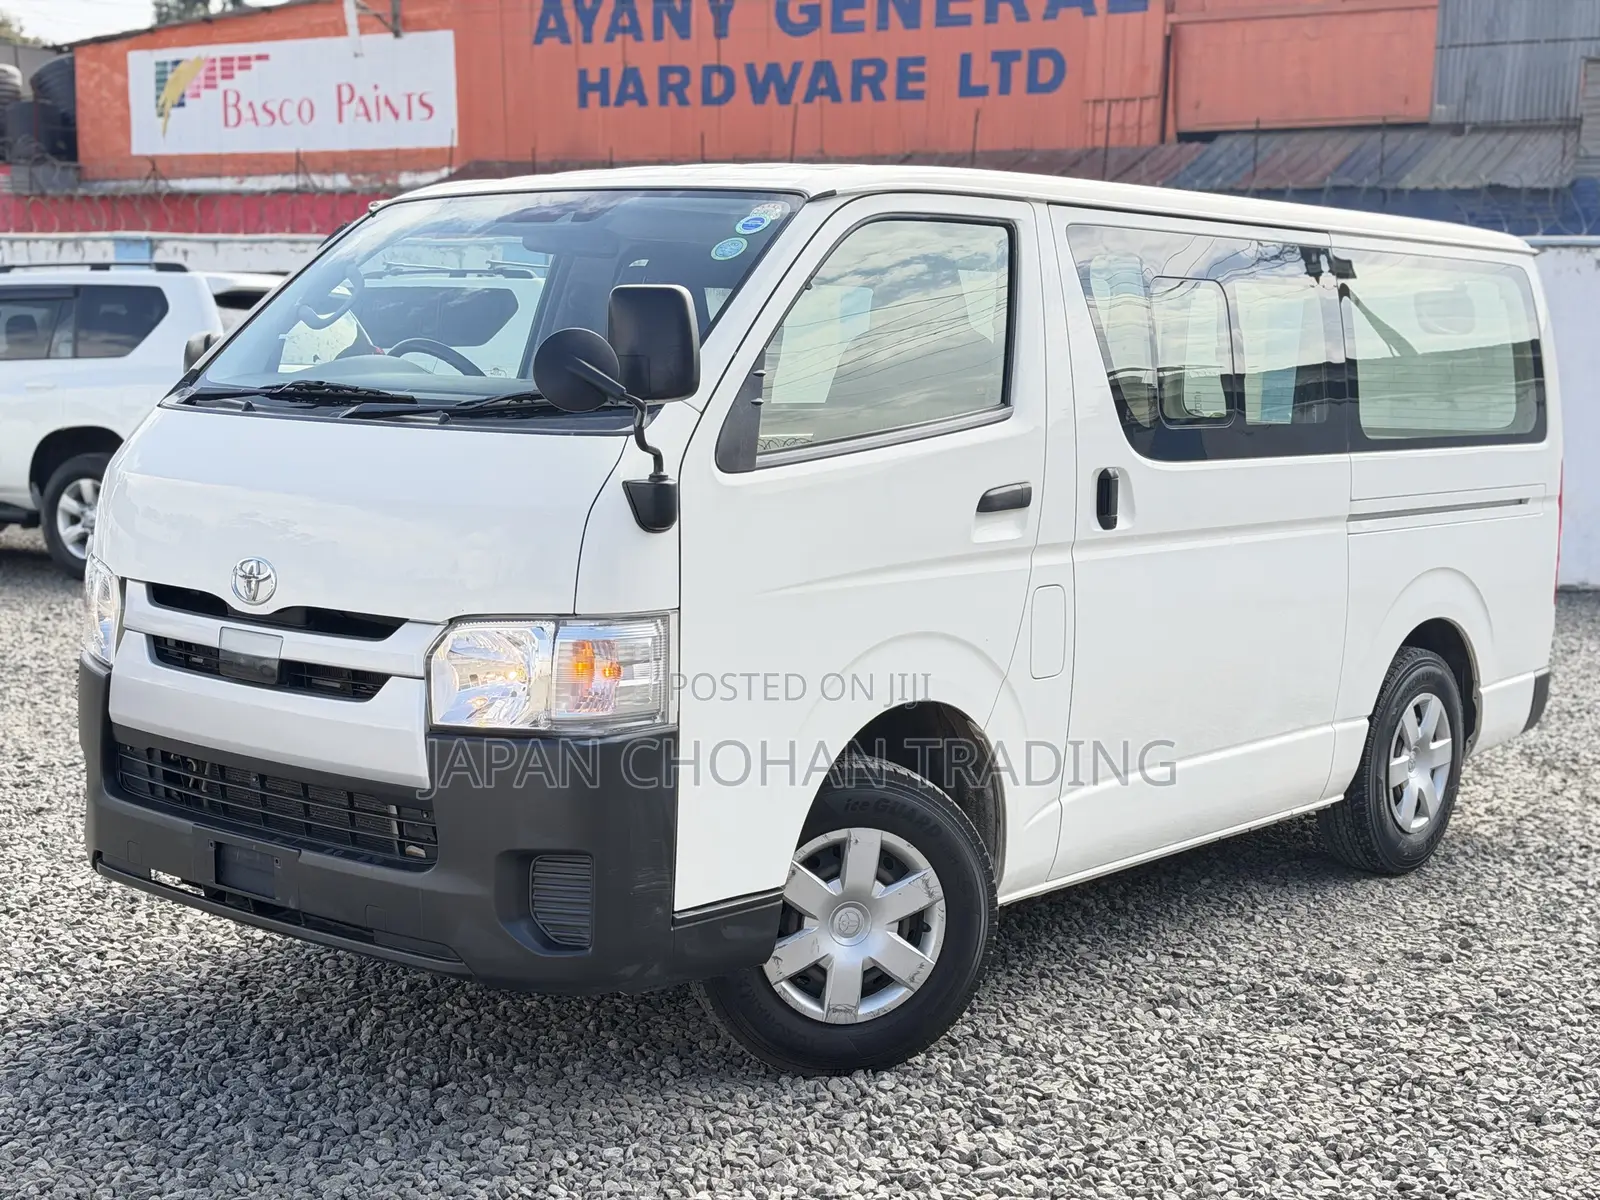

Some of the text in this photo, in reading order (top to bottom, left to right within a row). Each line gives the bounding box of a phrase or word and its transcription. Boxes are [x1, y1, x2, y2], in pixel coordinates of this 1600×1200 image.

[532, 0, 1149, 45] AYANY GENE
[577, 47, 1067, 109] HARDWARE LTD
